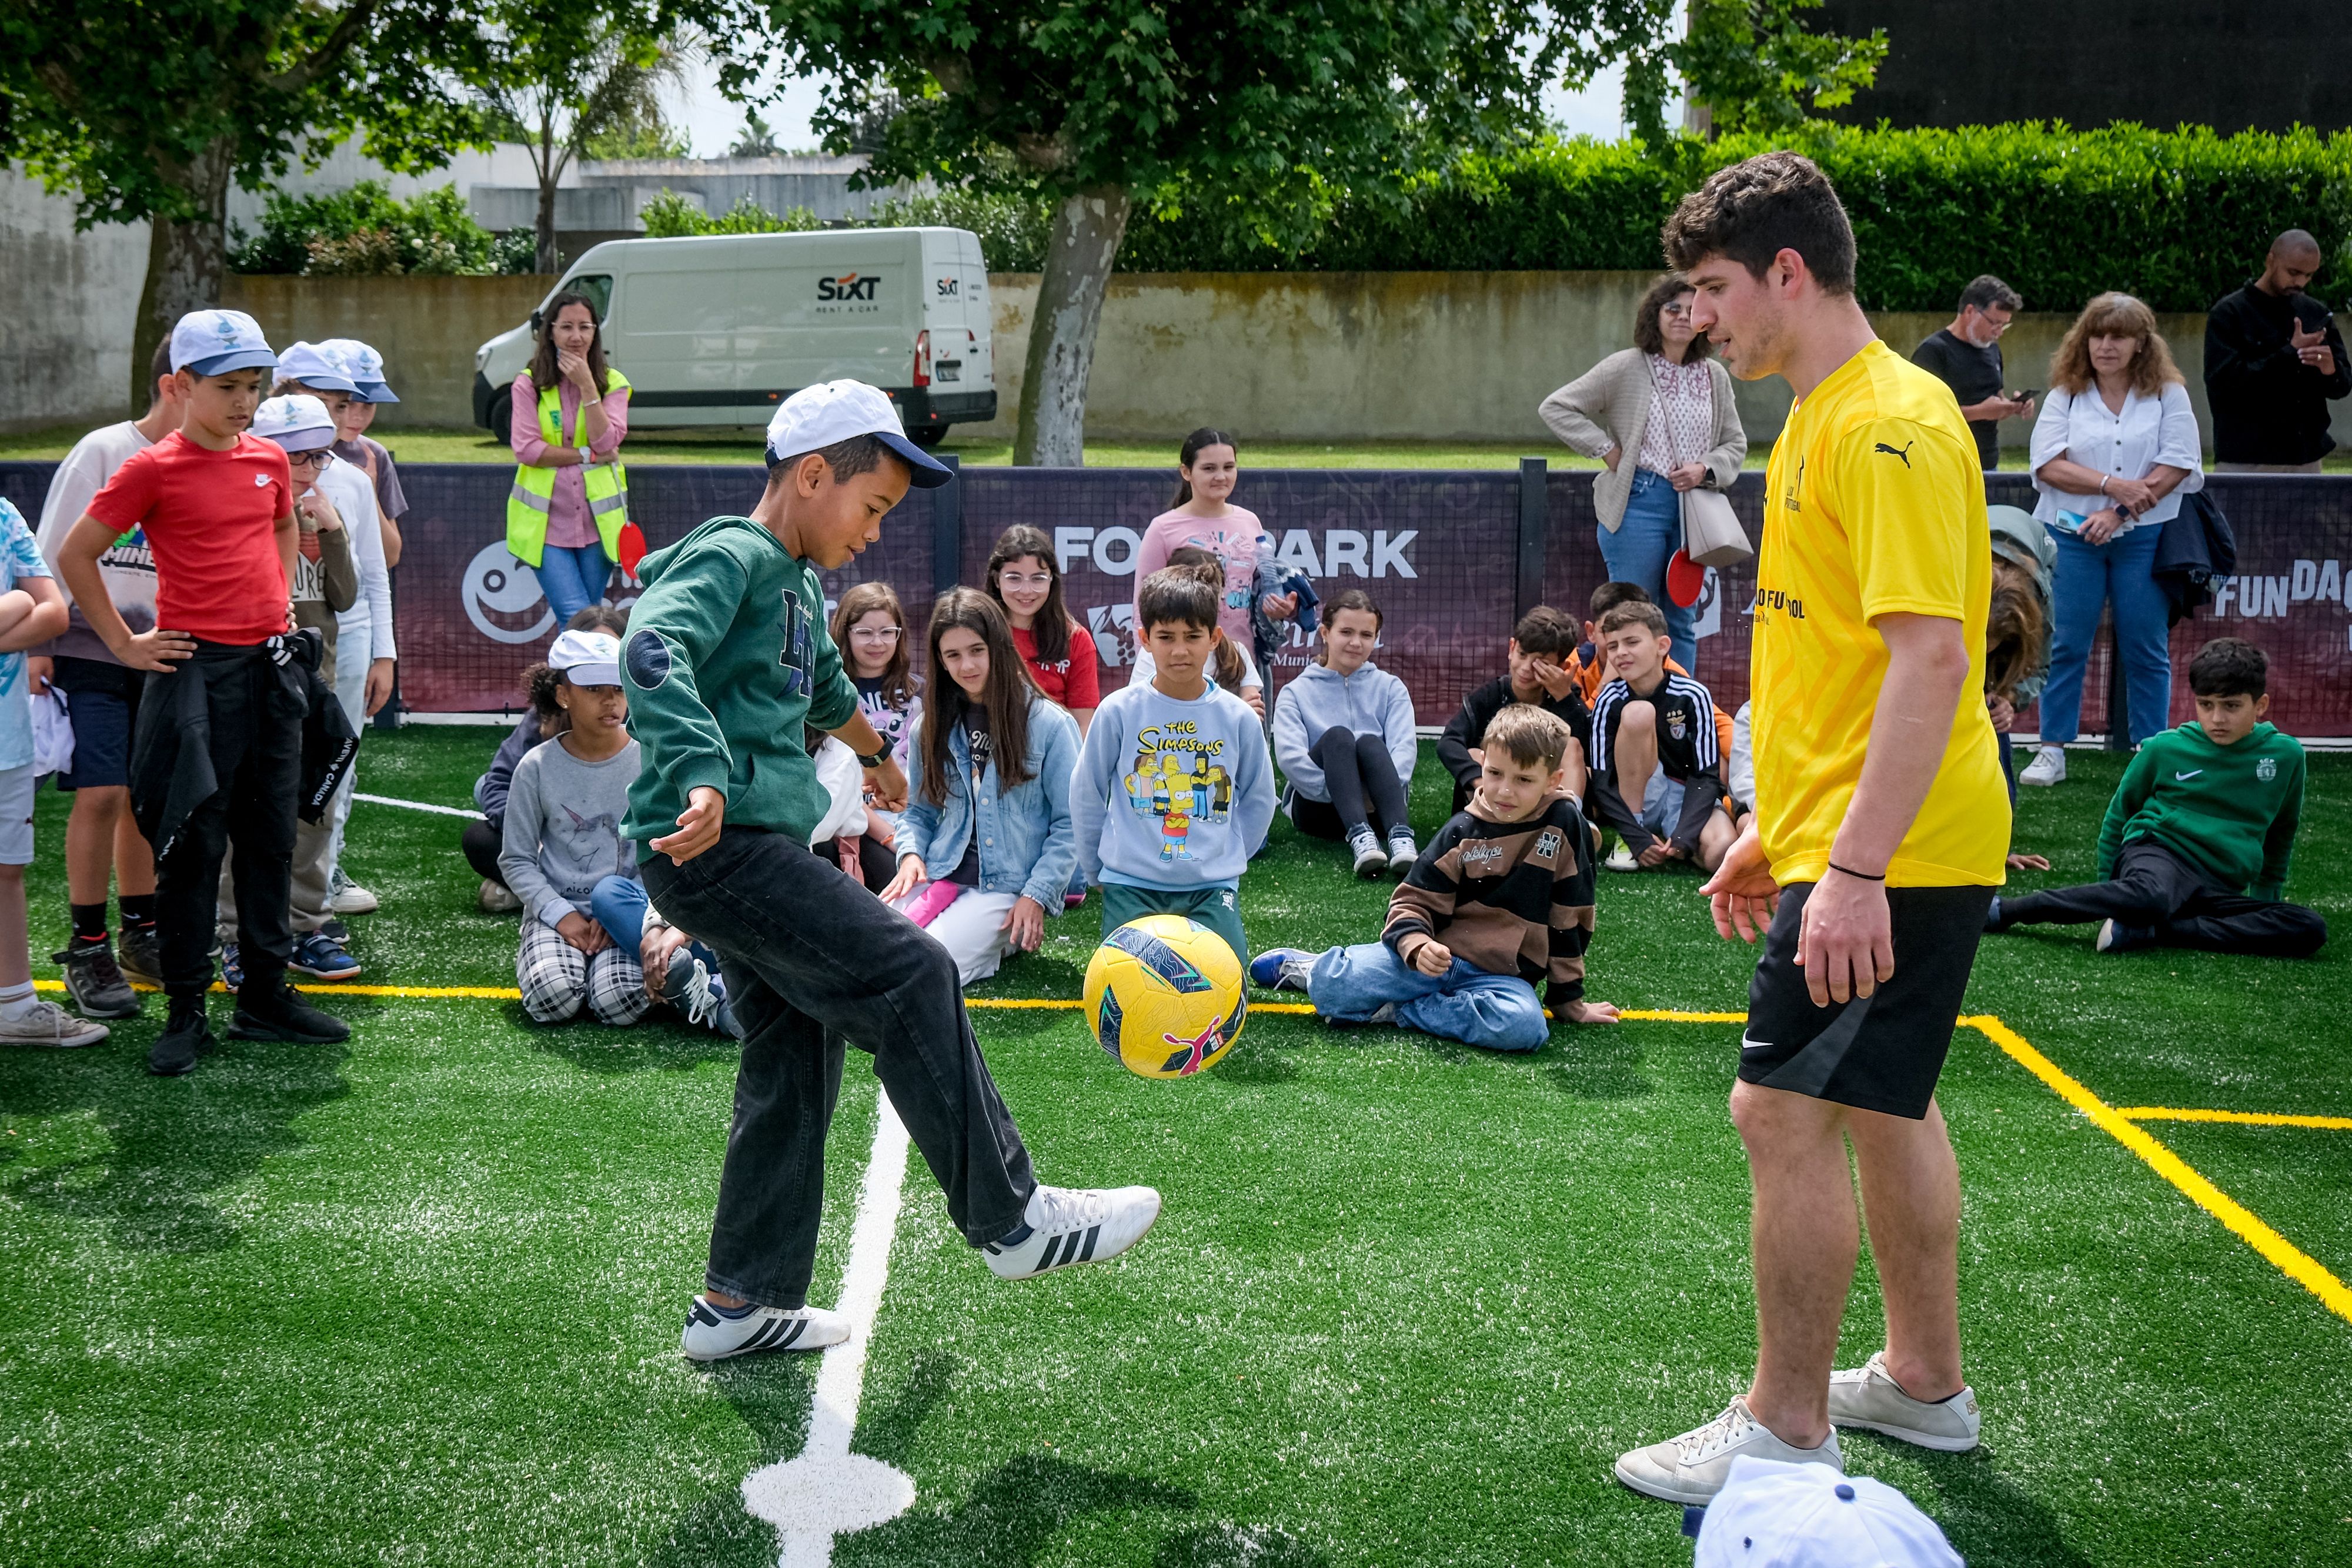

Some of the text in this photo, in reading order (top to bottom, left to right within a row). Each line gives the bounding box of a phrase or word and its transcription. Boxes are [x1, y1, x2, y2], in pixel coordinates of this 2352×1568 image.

[816, 306, 841, 314] RENT
[858, 305, 878, 313] CAR
[311, 773, 335, 806] CANADA
